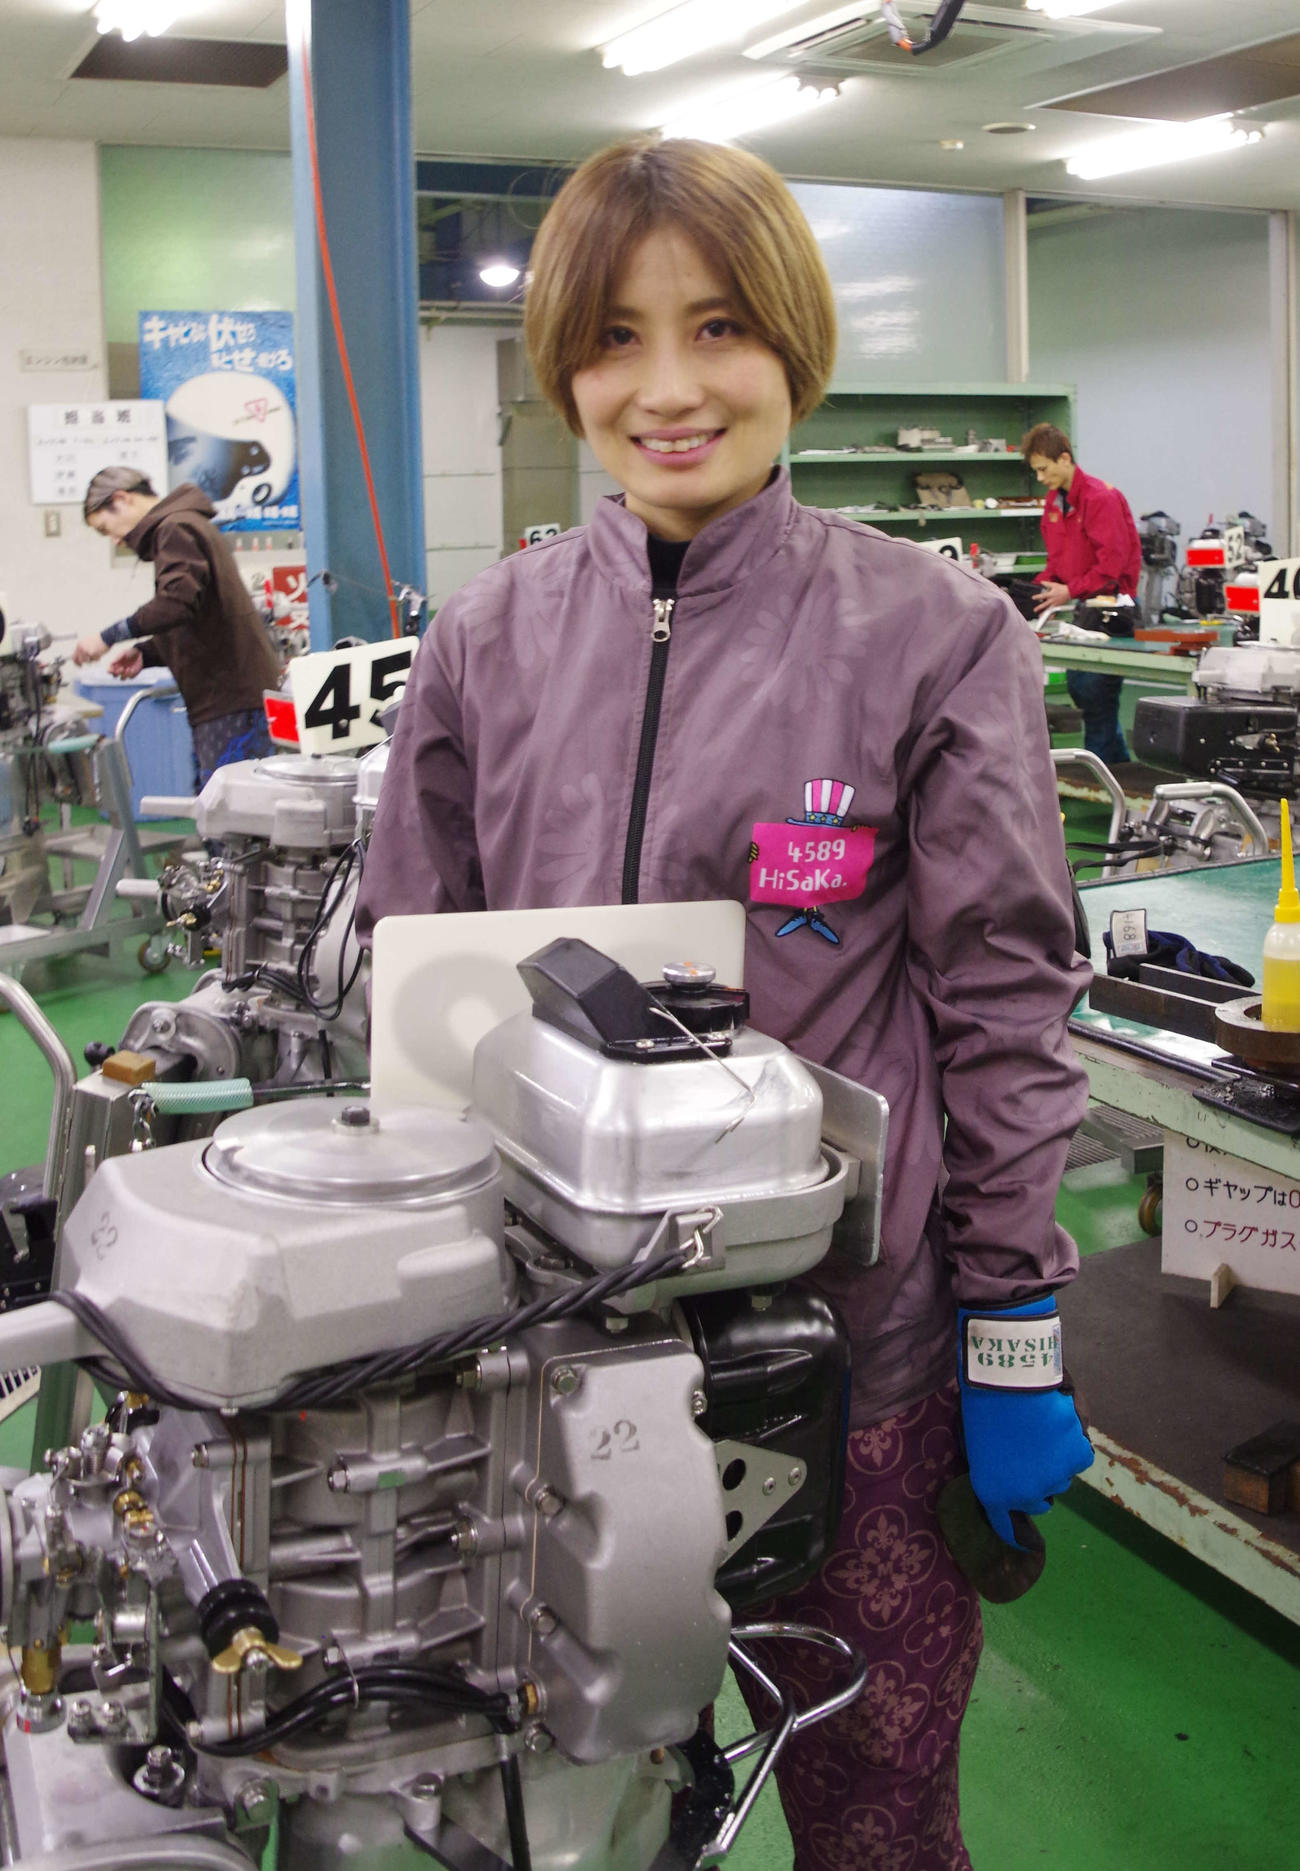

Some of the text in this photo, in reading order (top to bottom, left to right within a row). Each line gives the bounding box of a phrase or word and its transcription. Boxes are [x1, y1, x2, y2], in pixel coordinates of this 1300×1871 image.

[304, 650, 412, 740] 45
[787, 839, 846, 863] 4589
[971, 1335, 1058, 1353] HISAKA
[977, 1352, 1054, 1368] 4589
[589, 1419, 640, 1460] 22
